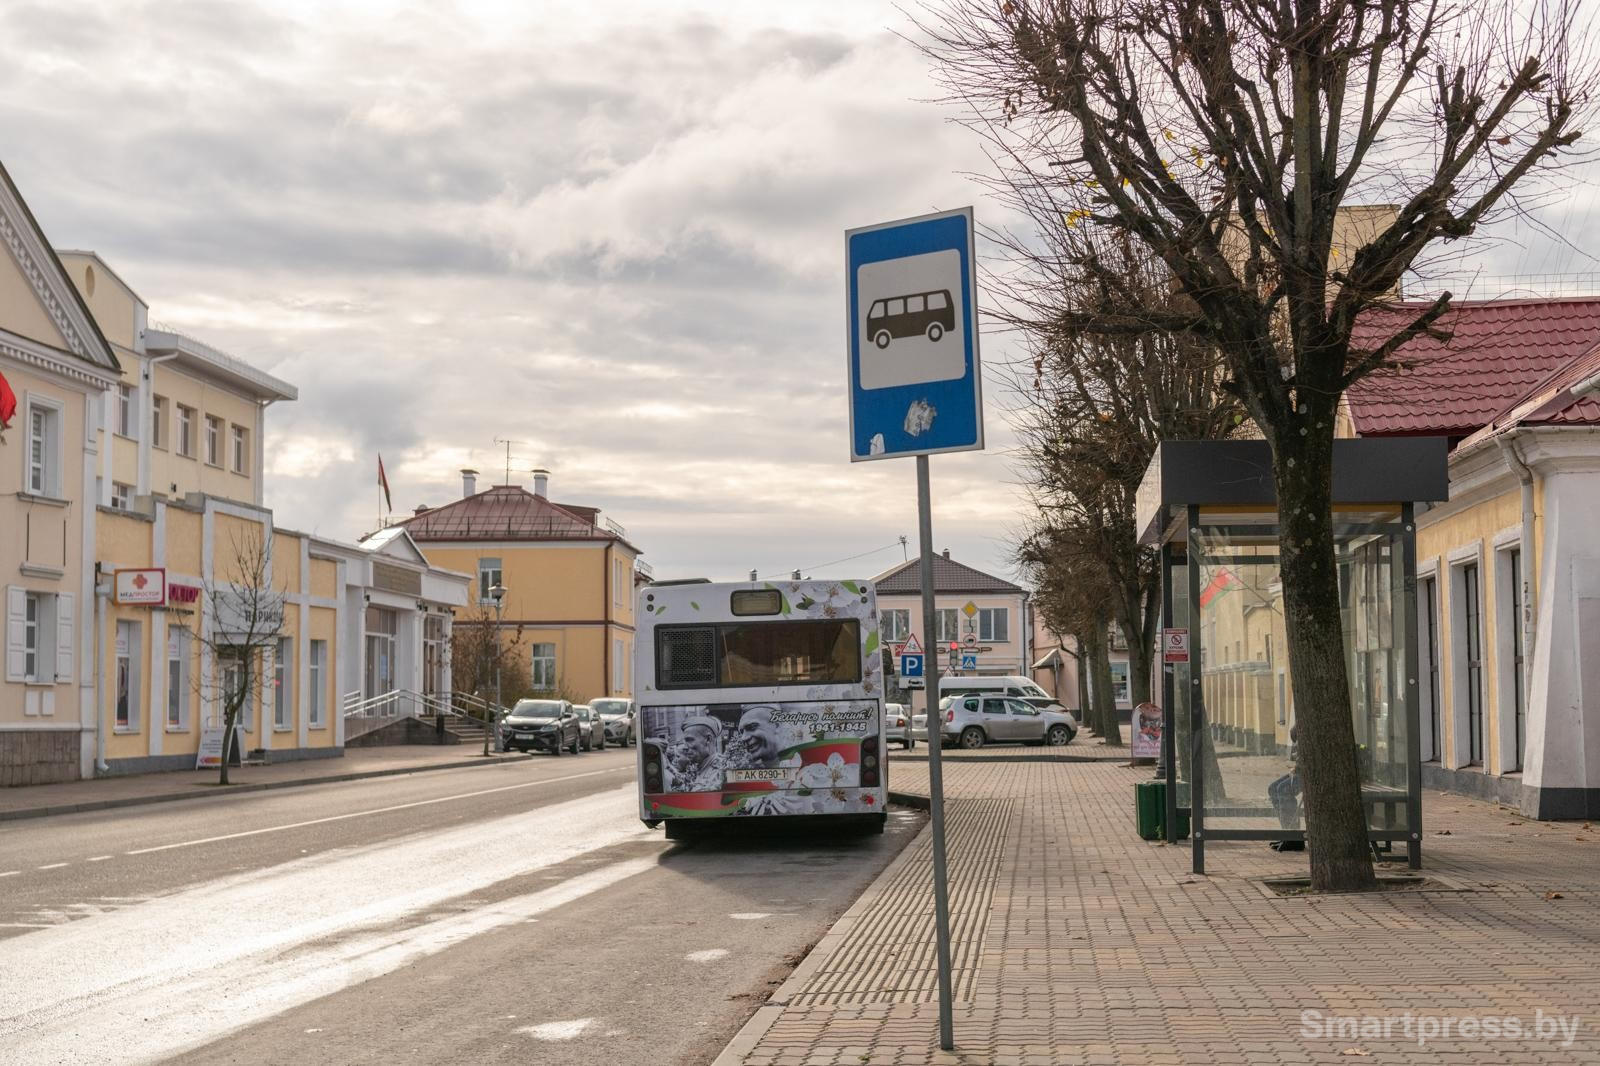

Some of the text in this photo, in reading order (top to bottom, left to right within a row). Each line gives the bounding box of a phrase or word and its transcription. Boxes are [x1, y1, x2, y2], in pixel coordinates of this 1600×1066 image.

[905, 657, 919, 675] P
[768, 706, 873, 725] Беларусь помнит!
[808, 721, 867, 733] 1941-1945
[758, 769, 786, 780] 8290-1
